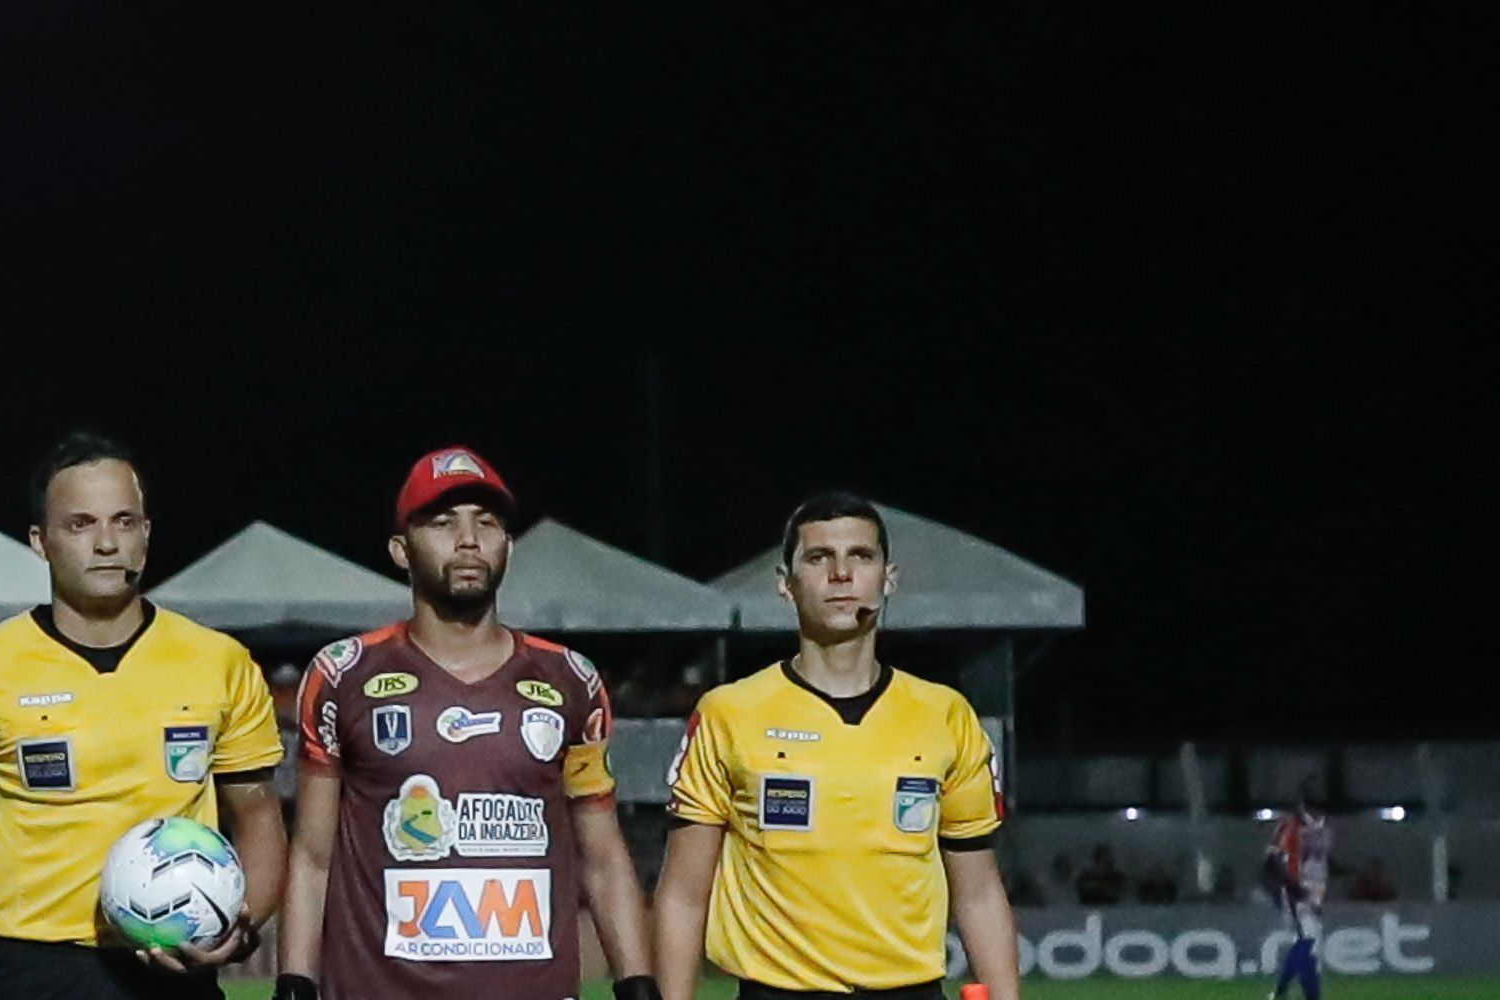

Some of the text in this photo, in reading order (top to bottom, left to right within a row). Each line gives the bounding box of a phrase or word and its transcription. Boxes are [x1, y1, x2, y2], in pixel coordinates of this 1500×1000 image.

[372, 676, 407, 694] JBS
[459, 798, 542, 821] AFOGADOS
[459, 823, 477, 841] DA
[398, 879, 544, 939] JAM
[394, 942, 545, 957] AR CONDICIONADO
